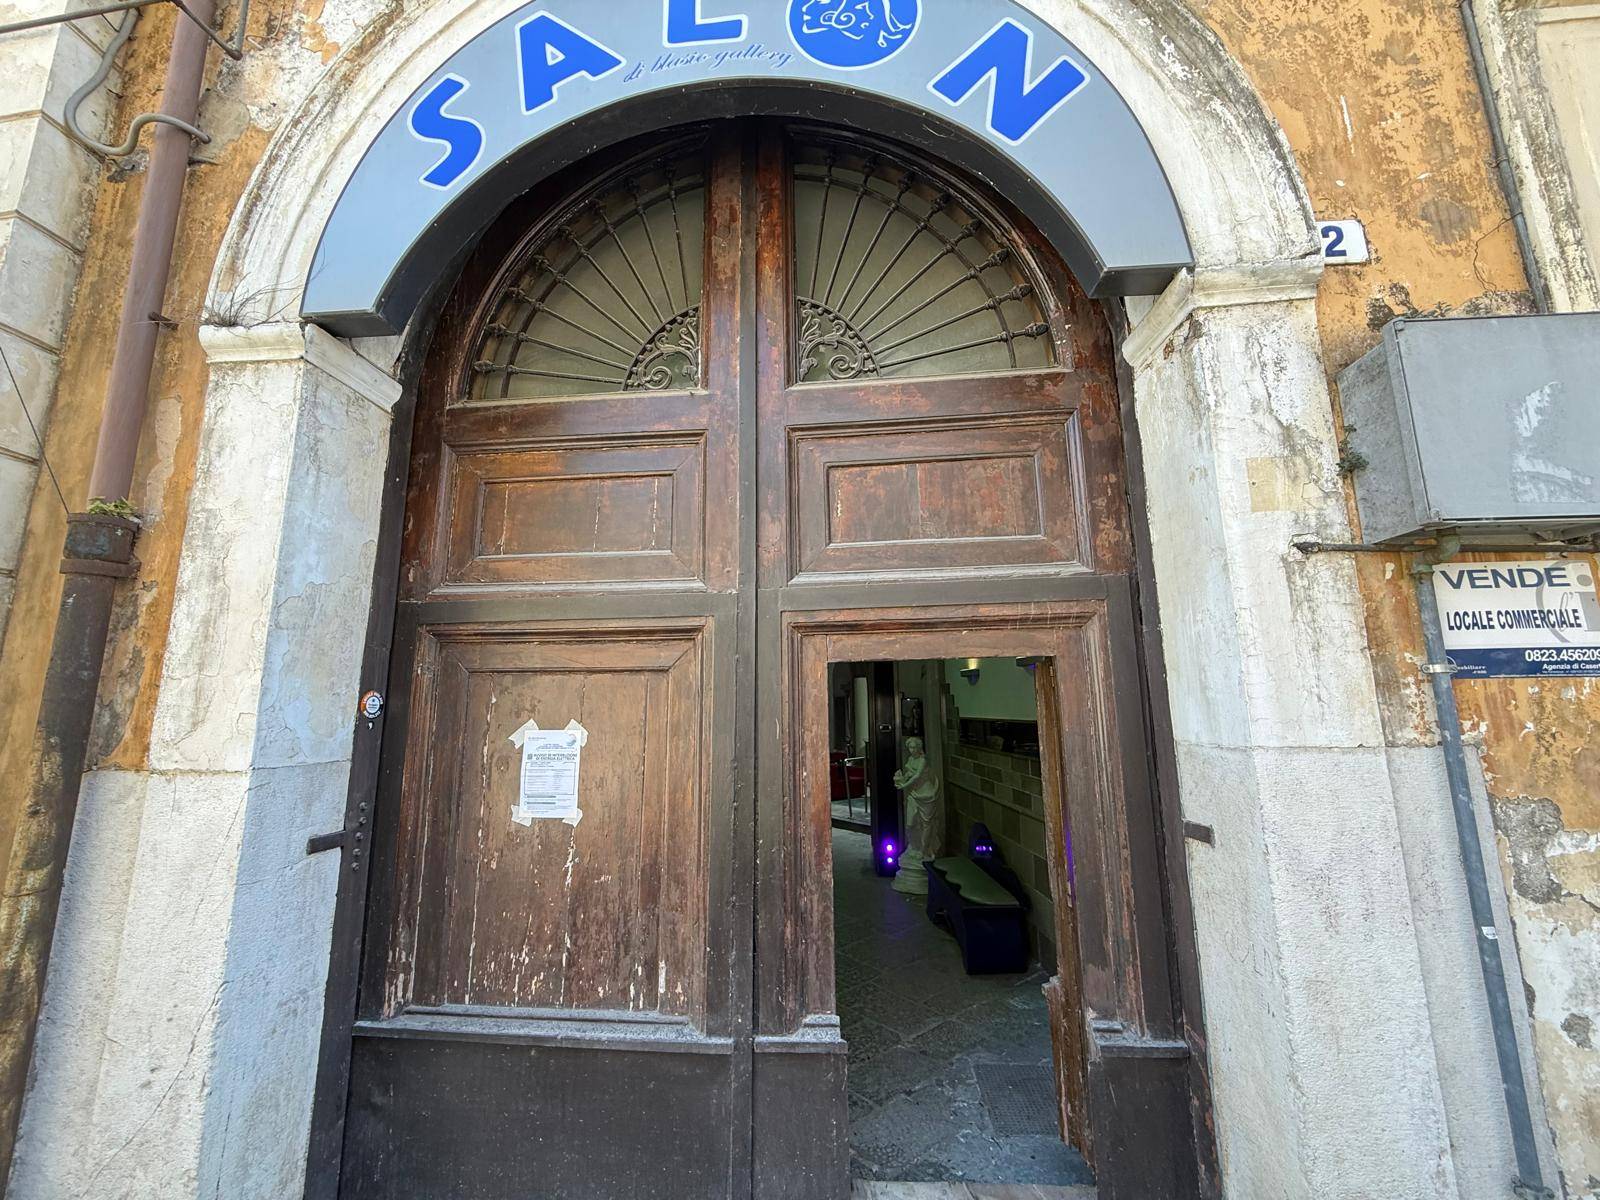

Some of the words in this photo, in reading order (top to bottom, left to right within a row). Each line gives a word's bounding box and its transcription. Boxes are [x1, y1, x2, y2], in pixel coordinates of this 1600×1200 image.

[623, 61, 645, 83] di
[650, 51, 711, 73] blasio
[709, 43, 794, 70] gallery
[1320, 225, 1347, 257] 2
[1439, 567, 1571, 589] VENDE
[1446, 610, 1495, 631] LOCALE
[1496, 608, 1582, 630] COMMERCIALE
[1542, 663, 1571, 671] Agenzia
